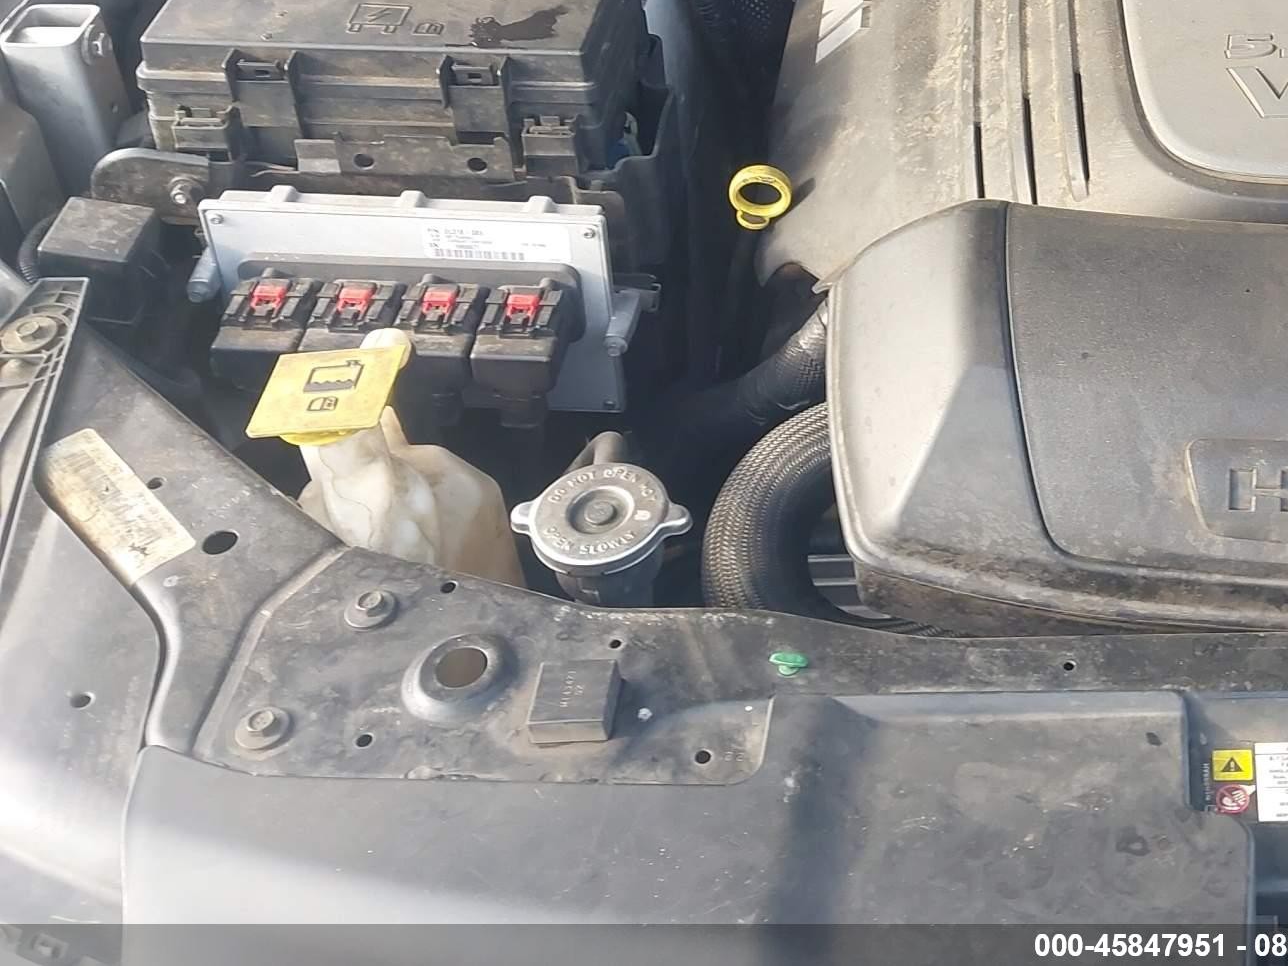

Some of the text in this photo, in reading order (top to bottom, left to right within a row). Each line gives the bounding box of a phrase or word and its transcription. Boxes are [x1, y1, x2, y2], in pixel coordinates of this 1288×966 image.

[567, 471, 596, 487] NOT
[603, 466, 640, 483] OPEN
[579, 530, 639, 555] SLOWLY
